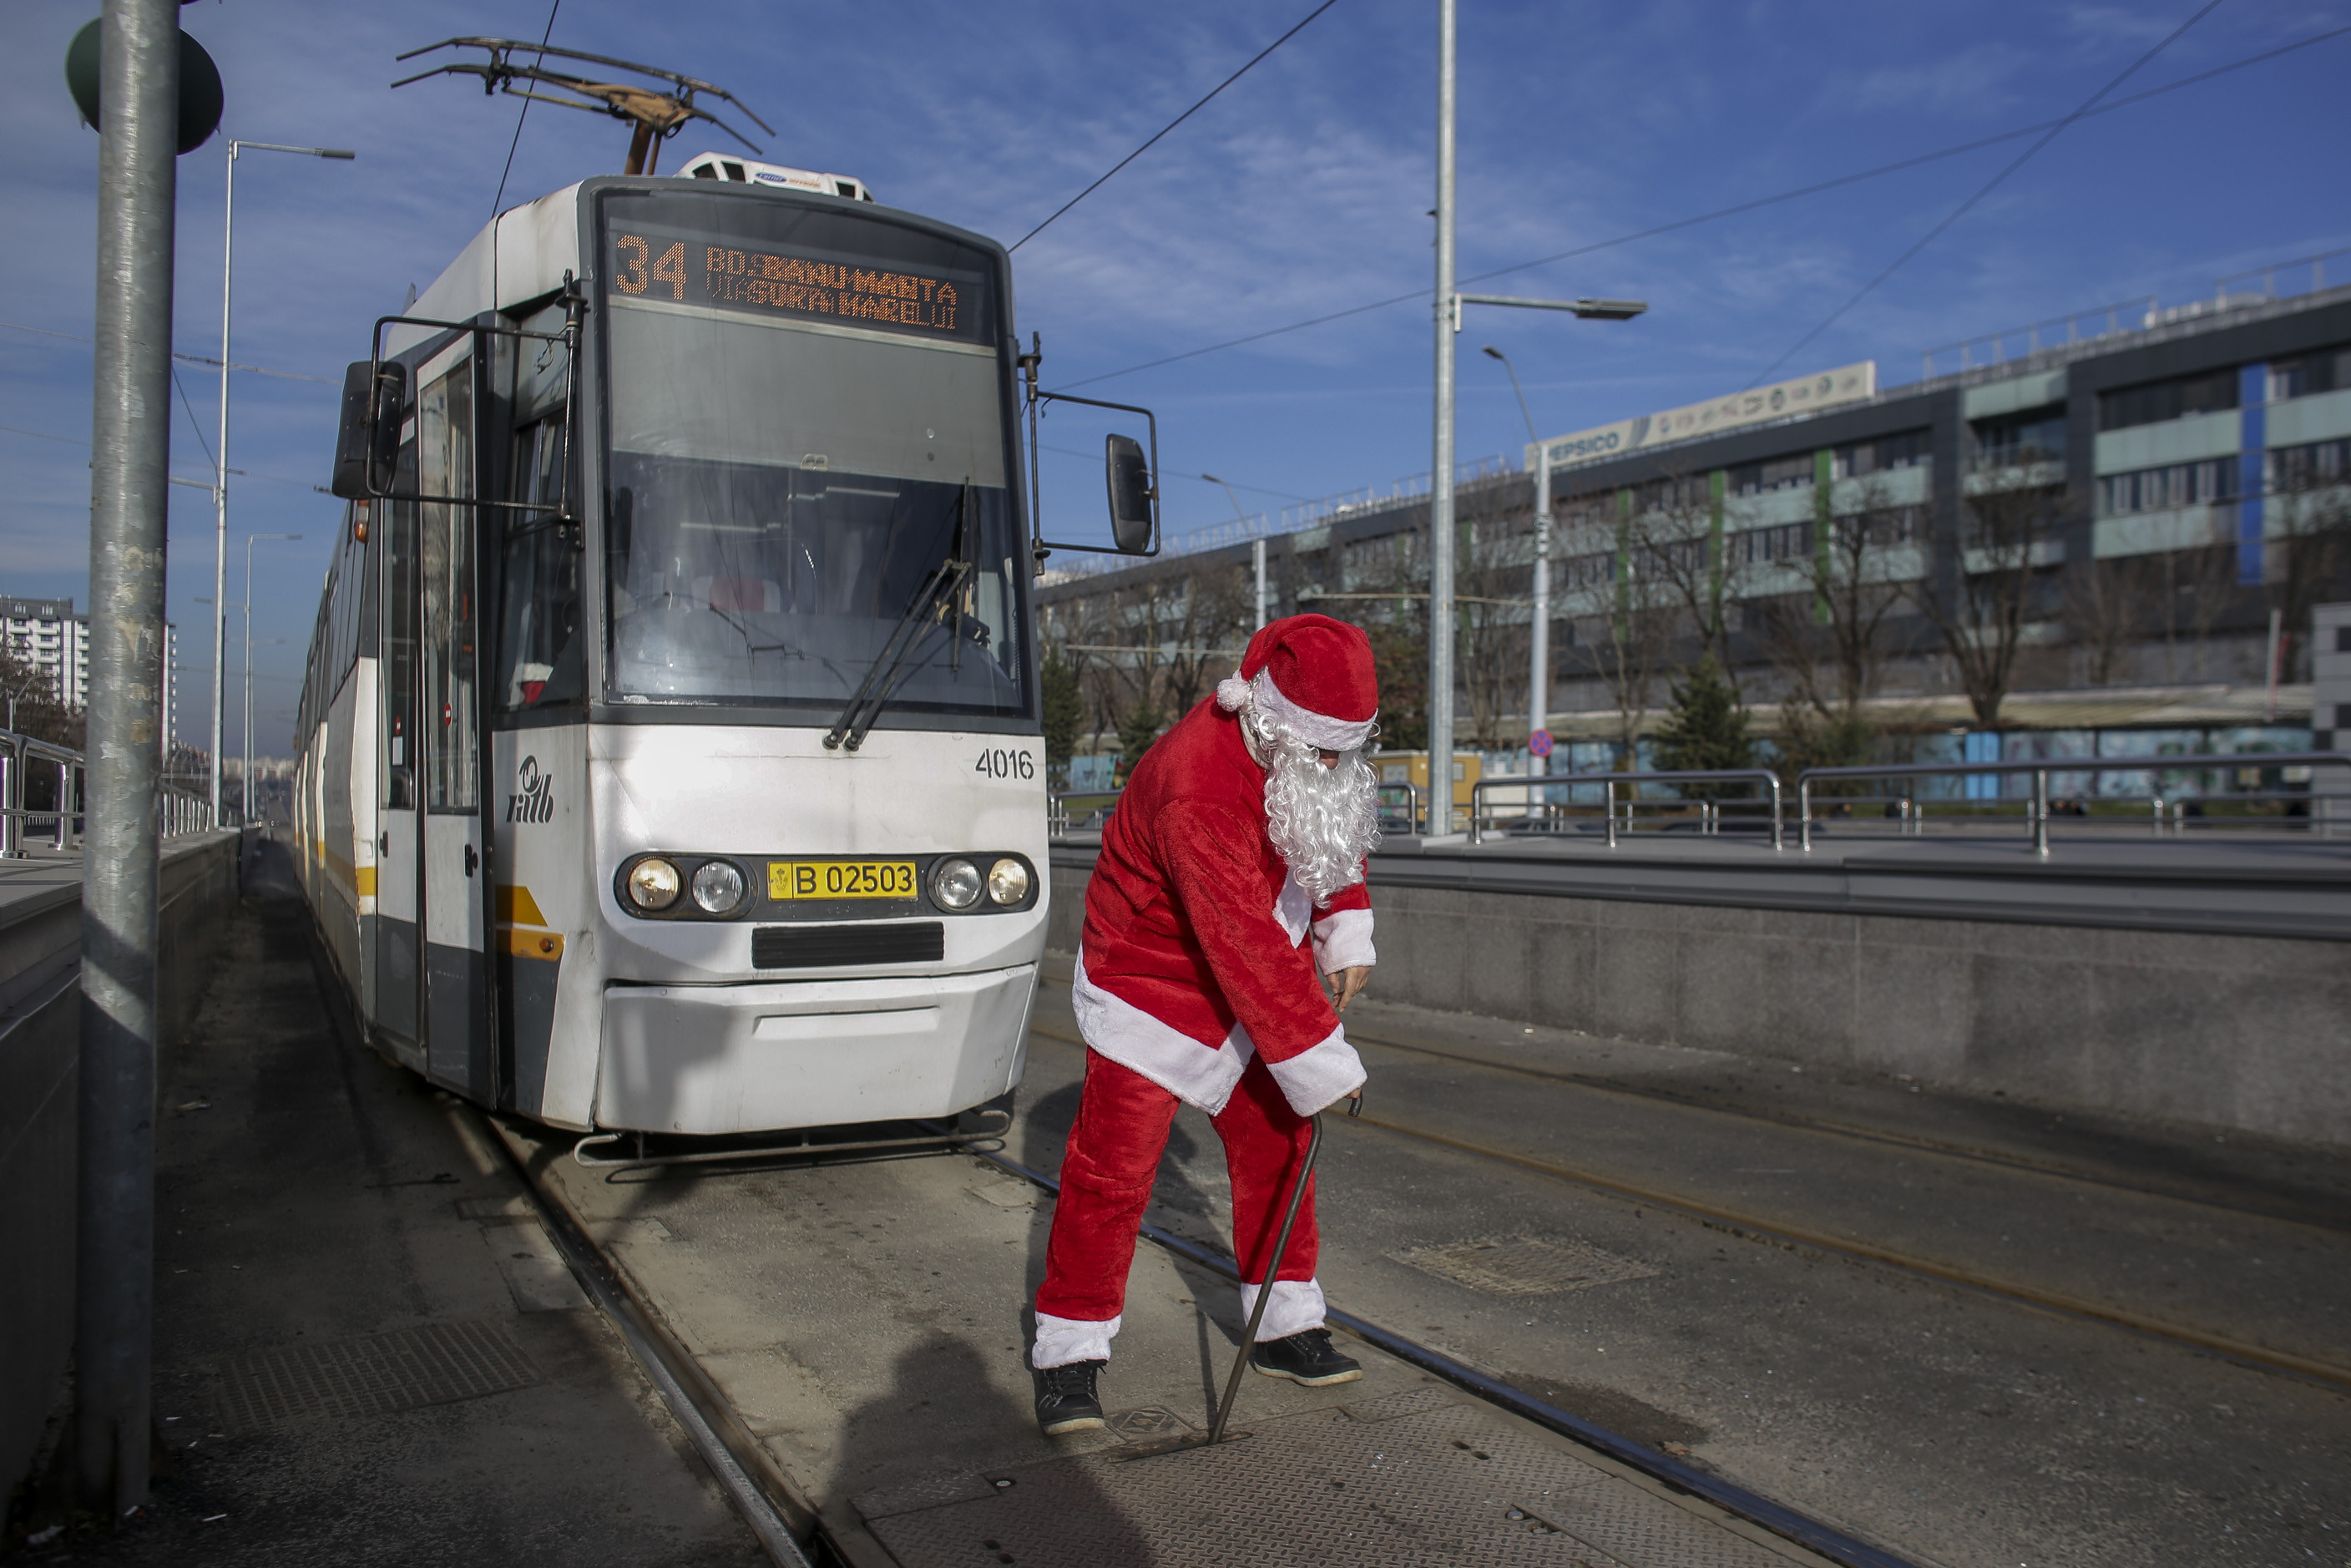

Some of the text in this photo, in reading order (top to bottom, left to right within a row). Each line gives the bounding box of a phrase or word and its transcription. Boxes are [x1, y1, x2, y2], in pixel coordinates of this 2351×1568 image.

[616, 235, 686, 300] 34
[975, 748, 1034, 780] 4016
[796, 865, 913, 893] B 02503
